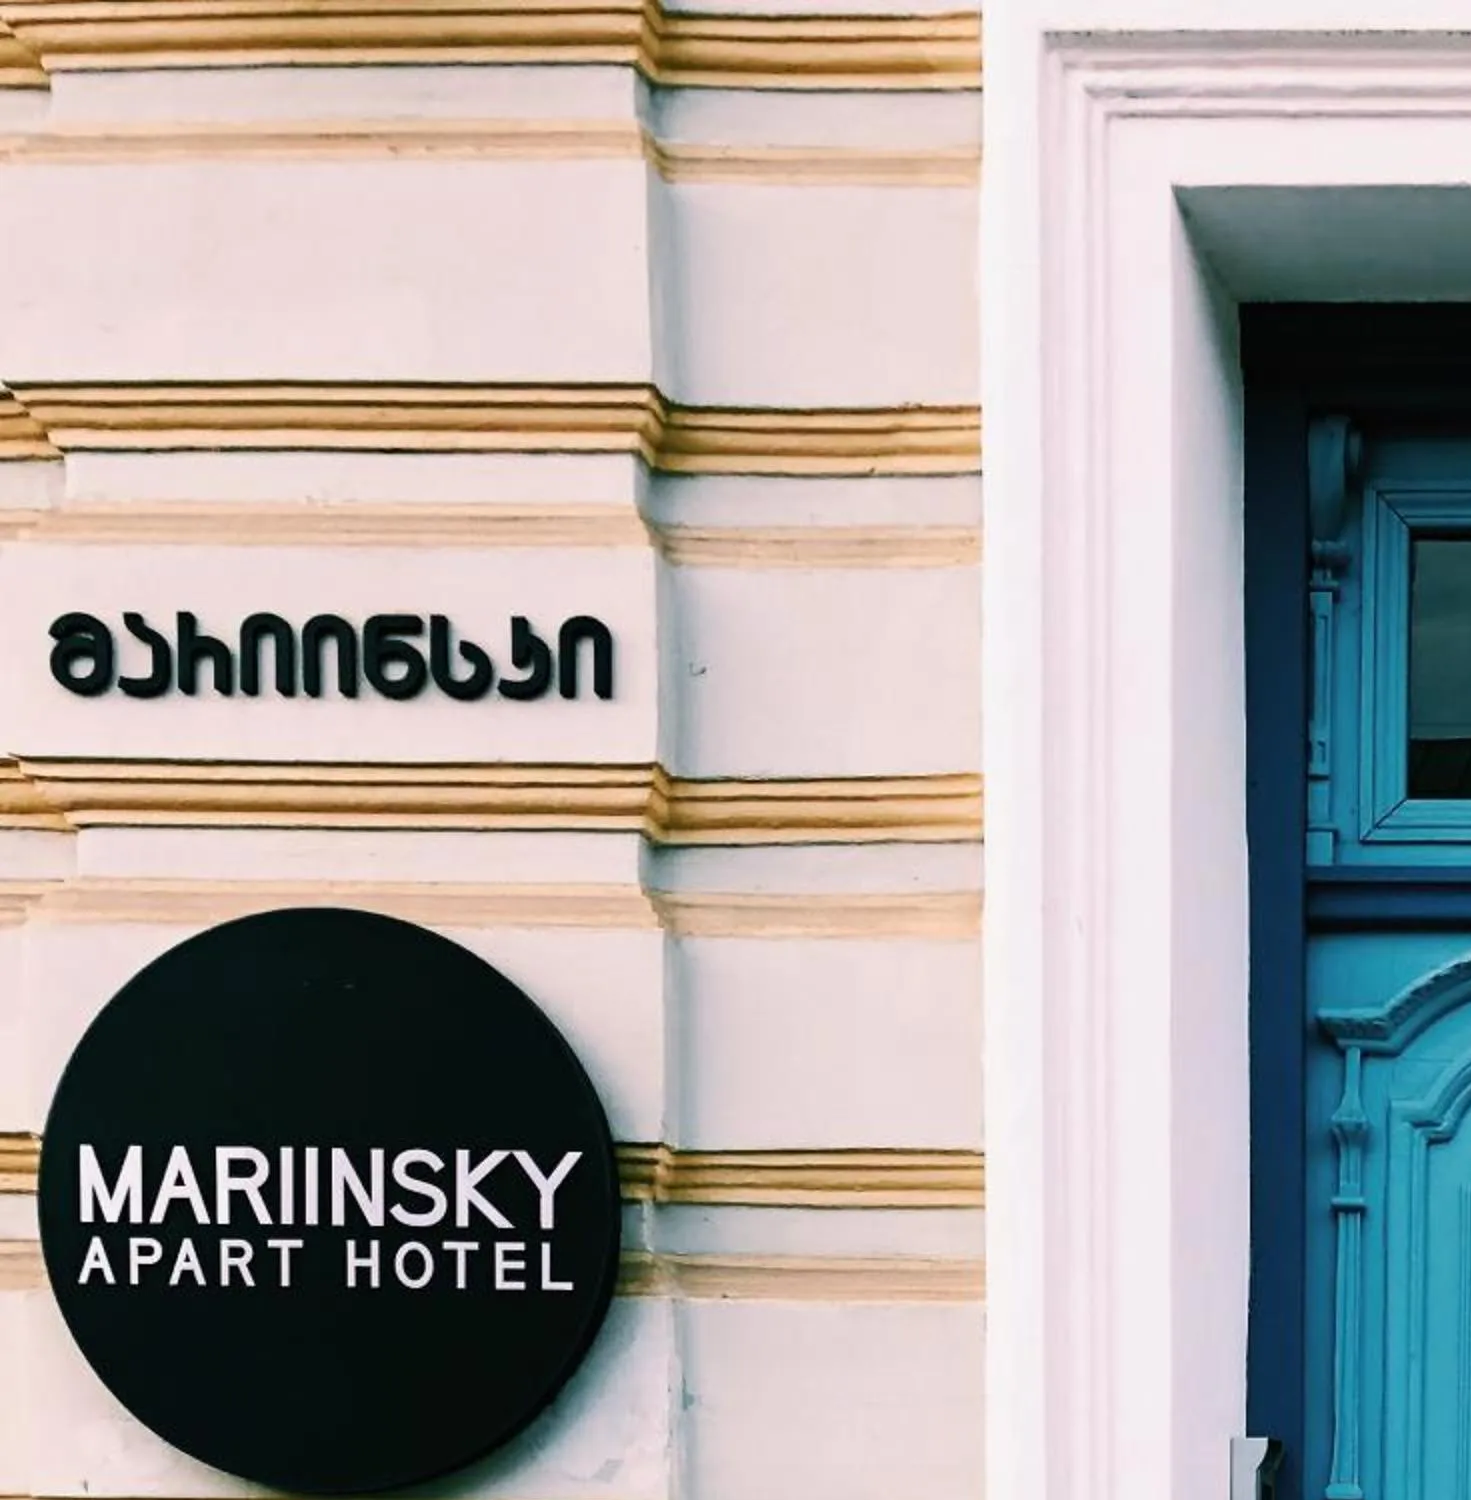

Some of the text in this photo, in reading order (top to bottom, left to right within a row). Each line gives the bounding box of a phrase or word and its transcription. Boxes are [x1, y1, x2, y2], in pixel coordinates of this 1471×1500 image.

[79, 1144, 583, 1229] MARIINSKY
[78, 1236, 574, 1291] APART HOTEL
